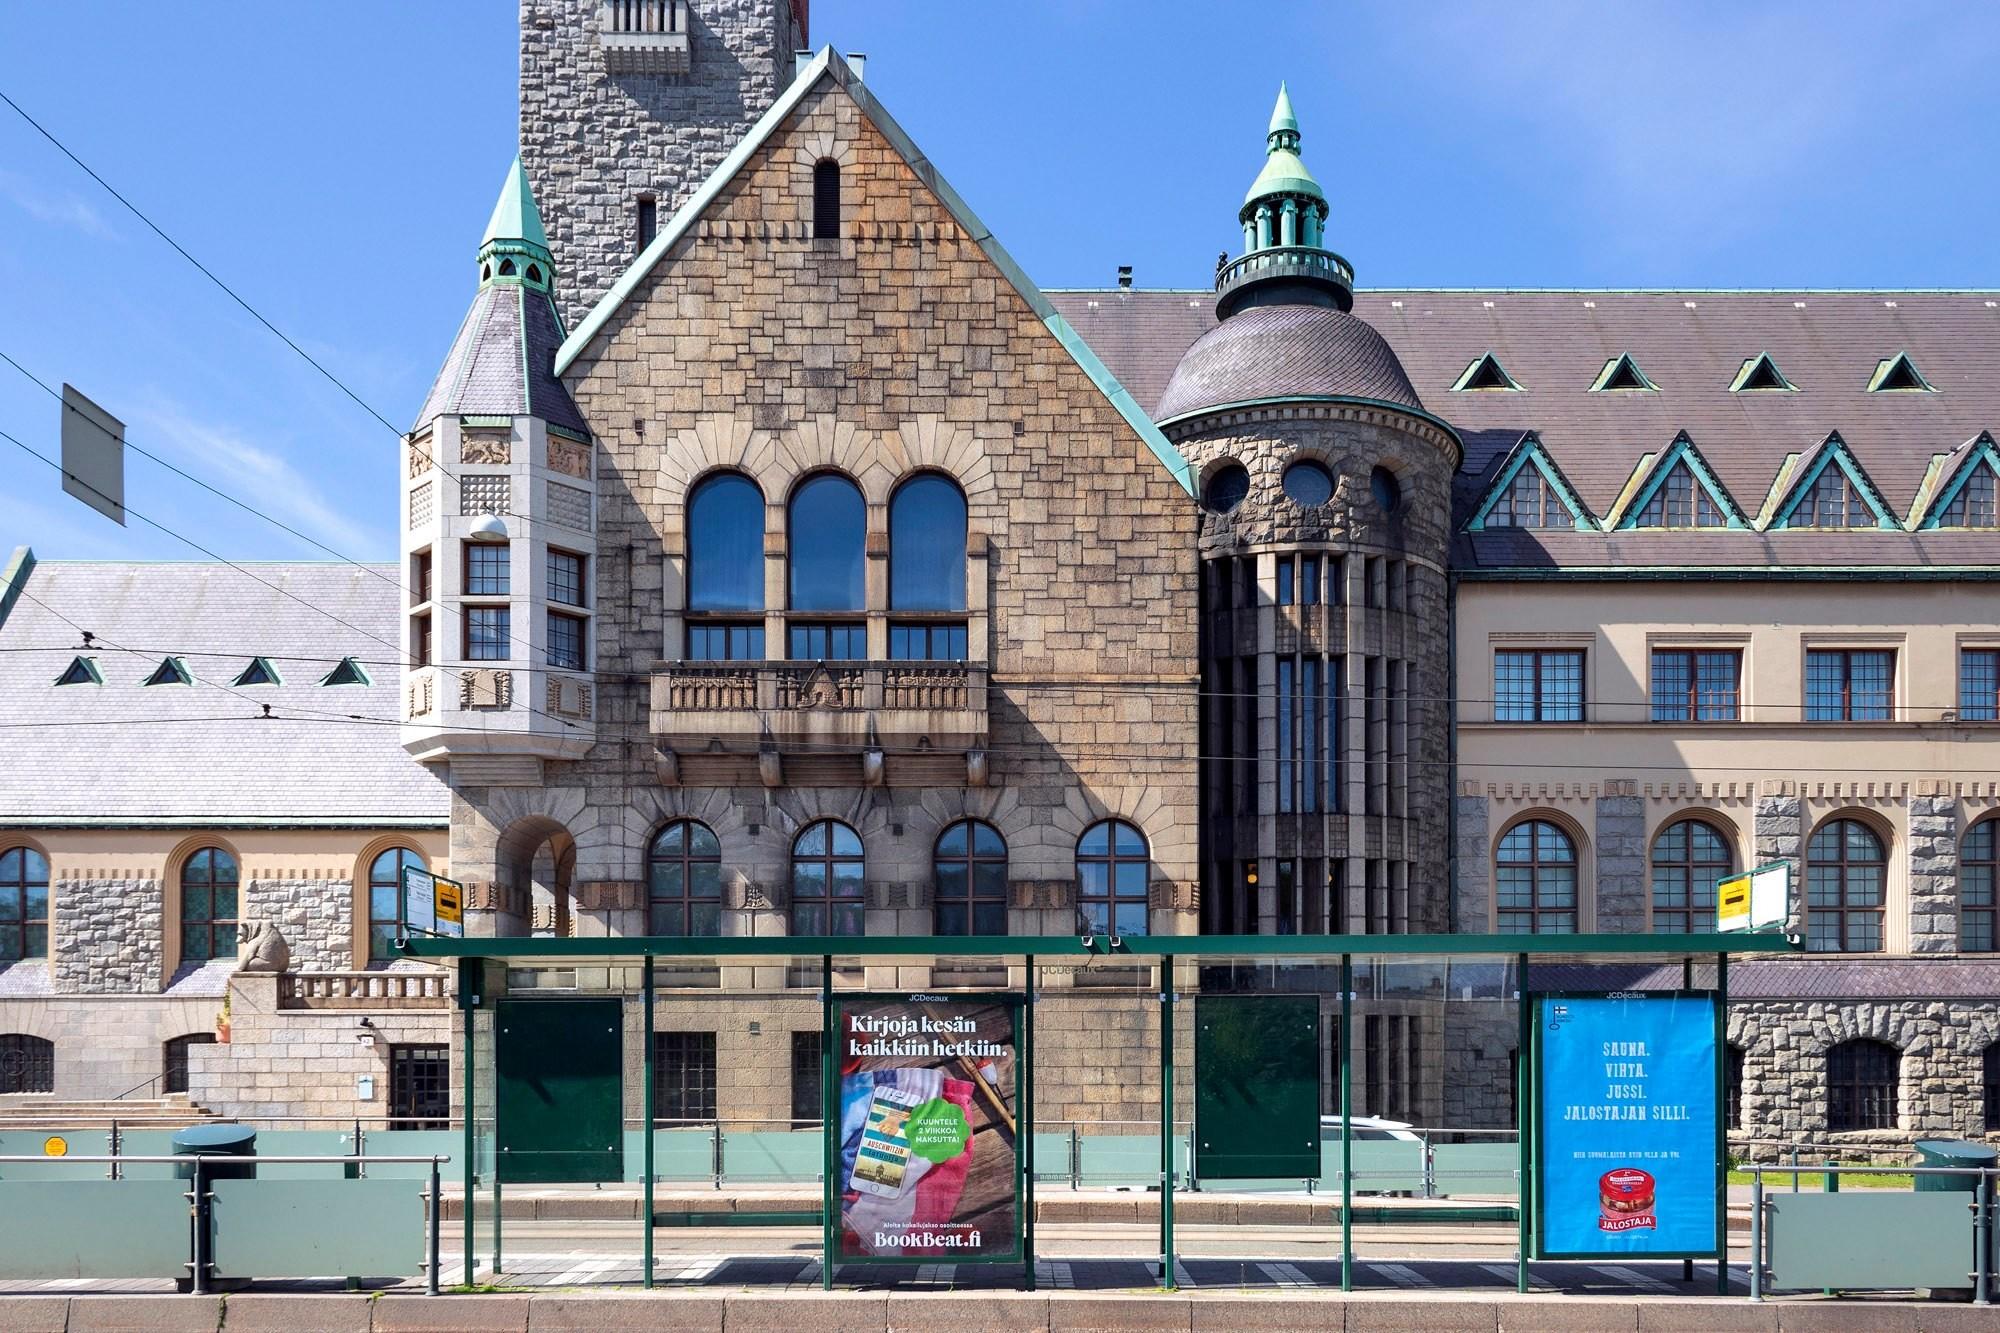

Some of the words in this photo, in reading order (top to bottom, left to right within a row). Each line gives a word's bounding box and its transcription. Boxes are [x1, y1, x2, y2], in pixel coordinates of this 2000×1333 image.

[1042, 966, 1097, 975] JCDecaux
[908, 994, 949, 1002] JCDecaux
[850, 1015, 919, 1037] Kirjoja
[921, 1015, 977, 1033] kesän
[850, 1039, 931, 1057] kaikkiin
[932, 1039, 1008, 1057] hetkiin.
[1603, 1041, 1651, 1057] SAUNA.
[1606, 1063, 1649, 1078] VIHTA.
[1606, 1084, 1648, 1099] JUSSI.
[1564, 1105, 1647, 1121] JALOSTAJAN
[1652, 1105, 1691, 1121] SILLI.
[917, 1118, 958, 1126] KUUNTELE
[867, 1139, 905, 1156] AUSCHWITZIN
[1602, 1216, 1651, 1230] JALOSTAJA
[875, 1230, 981, 1247] BookBeat.fi
